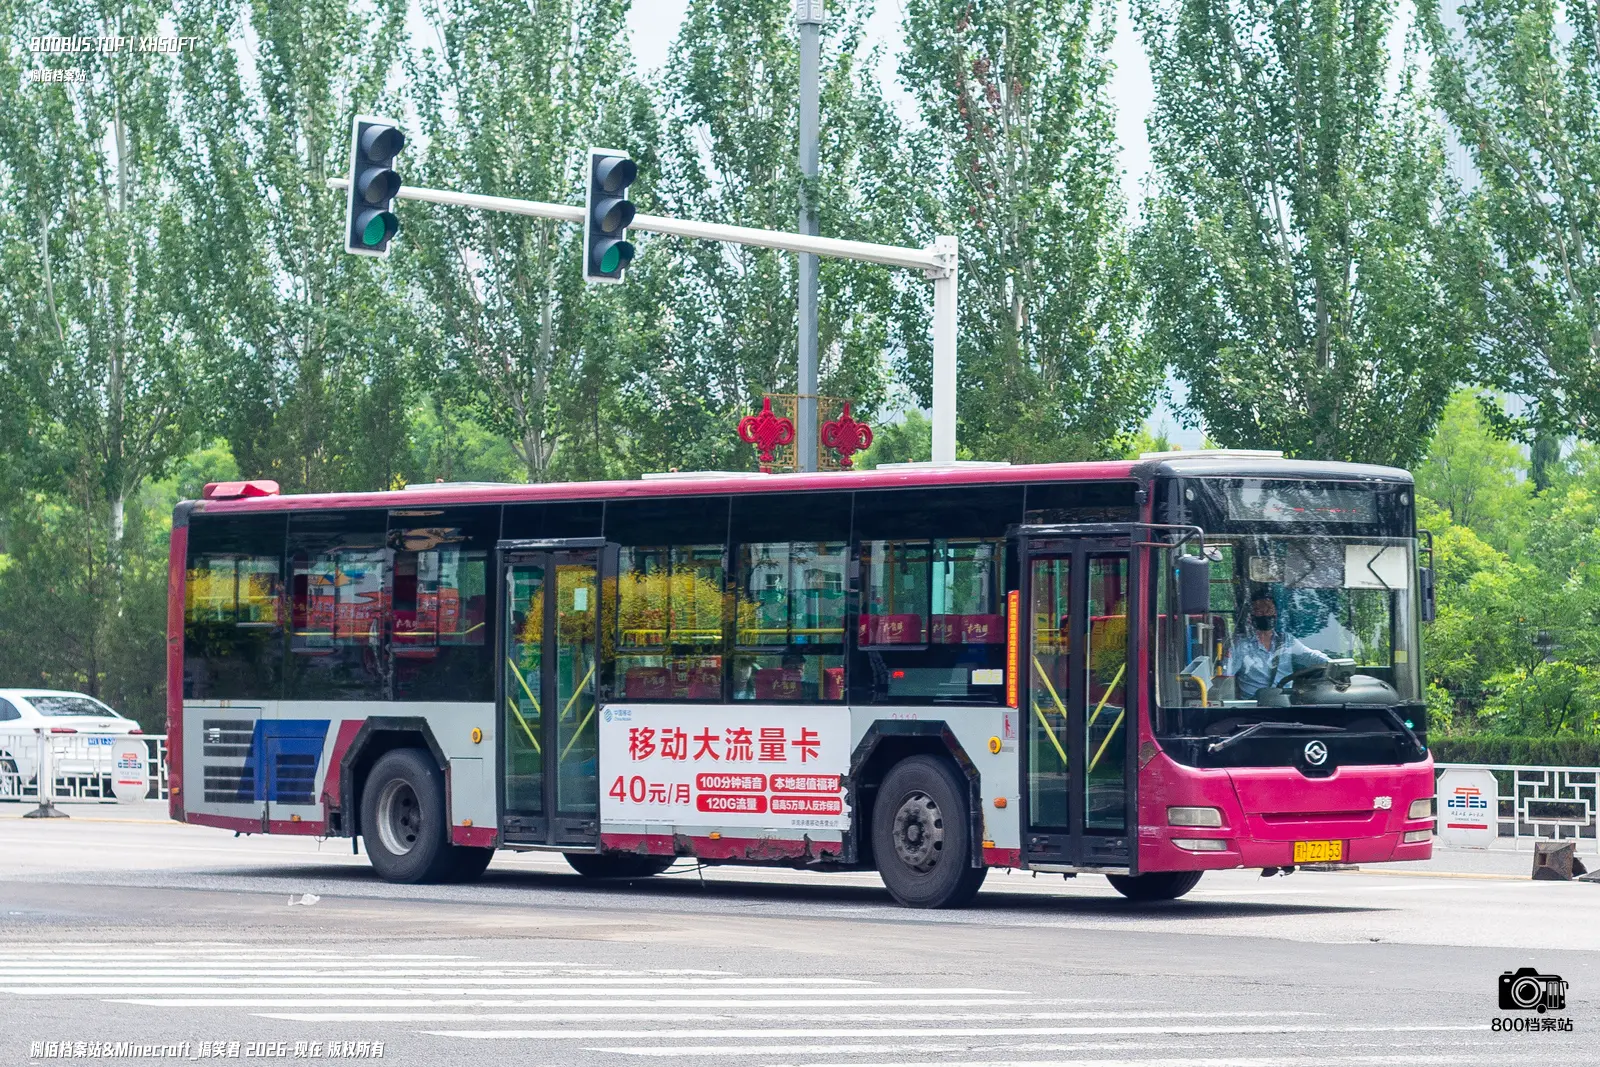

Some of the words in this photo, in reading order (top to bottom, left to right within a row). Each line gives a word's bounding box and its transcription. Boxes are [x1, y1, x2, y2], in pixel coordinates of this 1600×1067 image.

[628, 726, 821, 763] 移动大流量卡
[608, 775, 691, 805] 40元/月
[699, 776, 763, 790] 100分钟语音
[773, 776, 839, 791] 本地超值福利
[705, 797, 758, 811] 120G流量
[771, 799, 841, 812] 最高5万单人反诈保障
